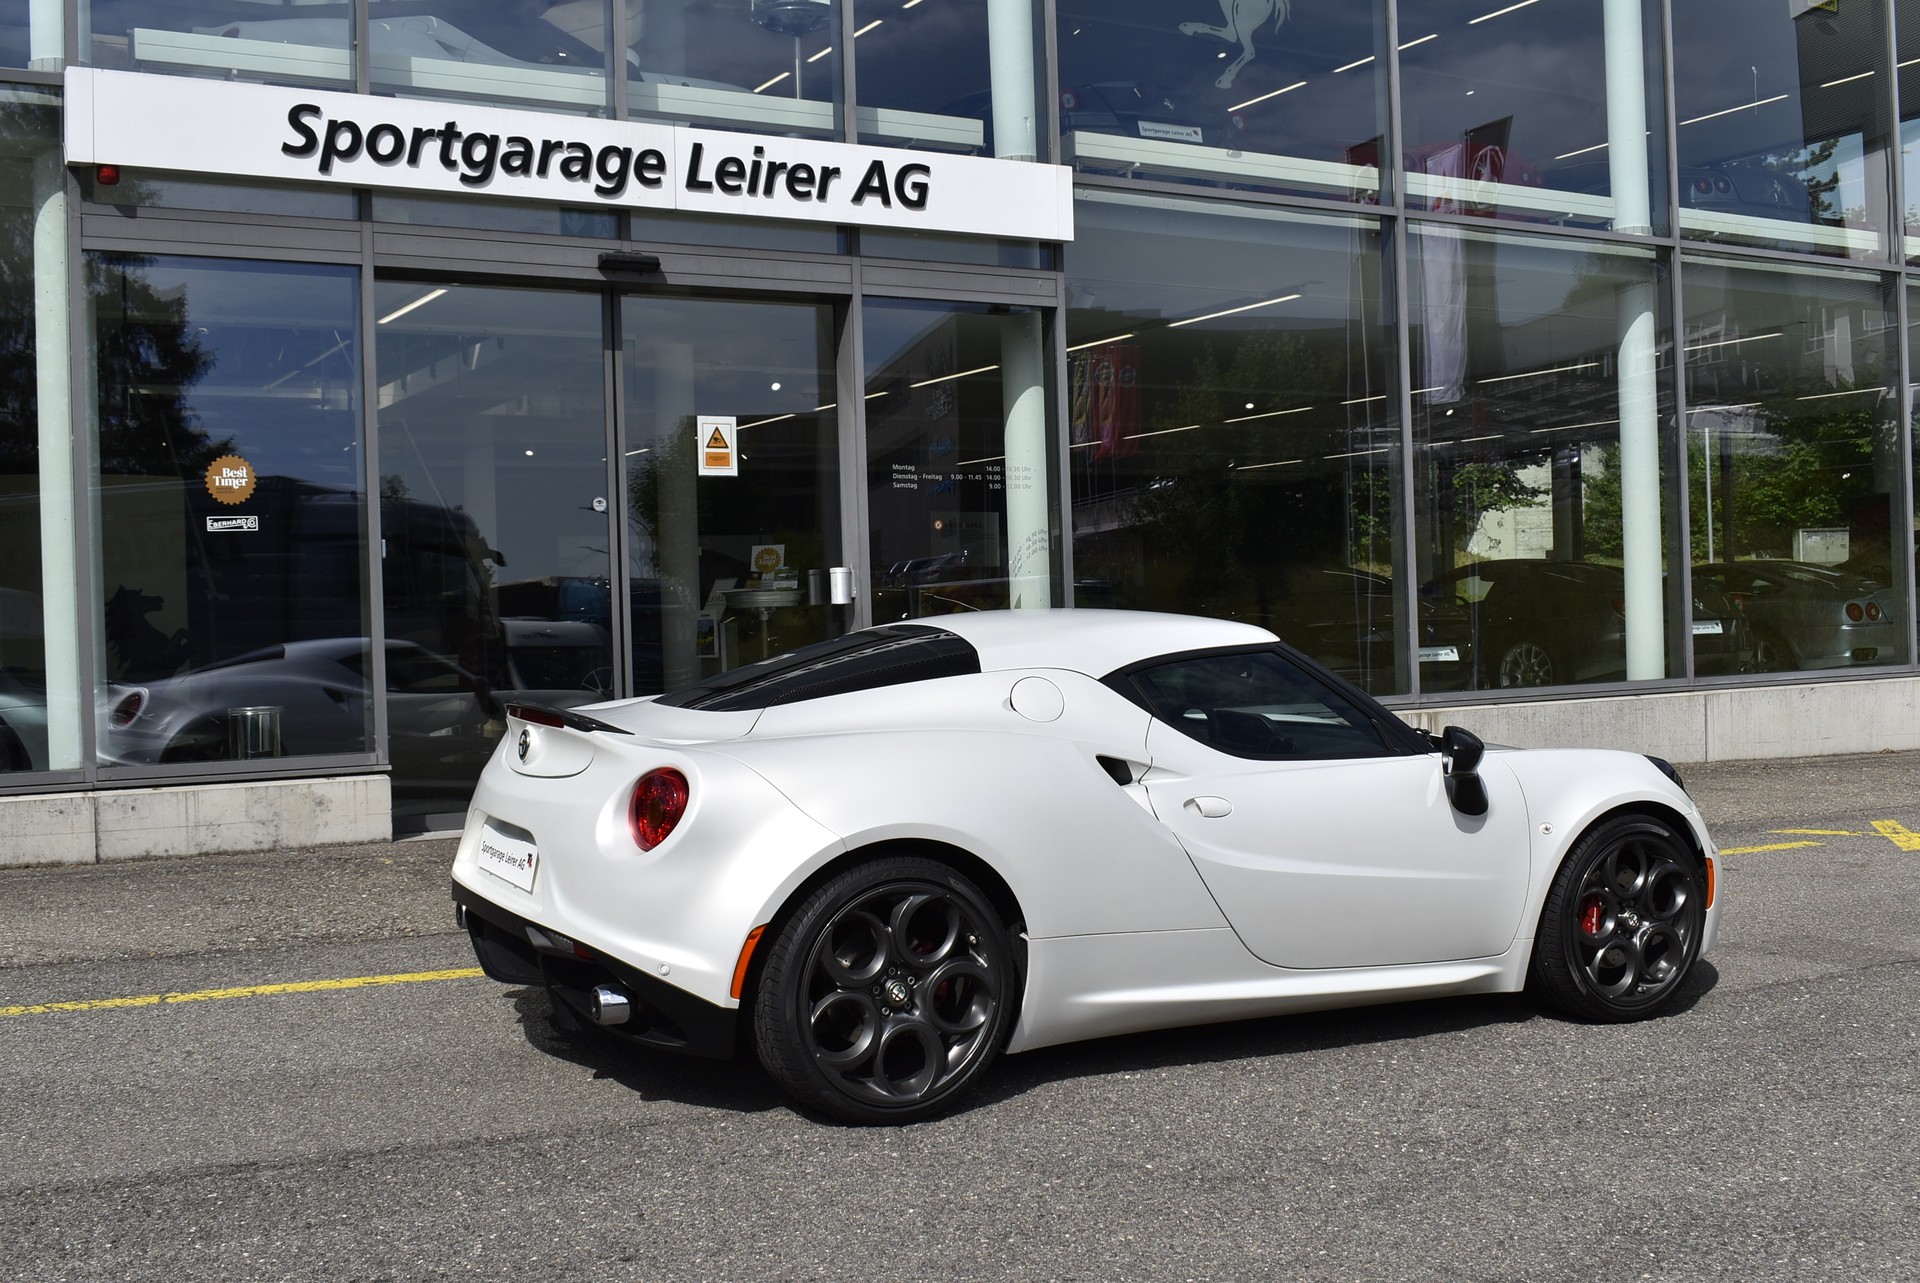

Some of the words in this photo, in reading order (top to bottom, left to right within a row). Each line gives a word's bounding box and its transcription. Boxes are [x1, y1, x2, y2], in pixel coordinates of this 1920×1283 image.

[1141, 126, 1170, 135] Sportgarage
[281, 103, 667, 197] Sportgarage
[685, 142, 841, 202] Leirer
[850, 159, 932, 210] AG
[222, 466, 248, 478] Best
[892, 464, 915, 472] Montag
[212, 475, 248, 489] Timer
[892, 473, 918, 481] Dienstag
[922, 473, 943, 481] Freitag
[892, 481, 918, 490] Samstag
[482, 841, 505, 863] Sportgarage
[505, 851, 518, 867] Leirer
[517, 858, 526, 871] AG
